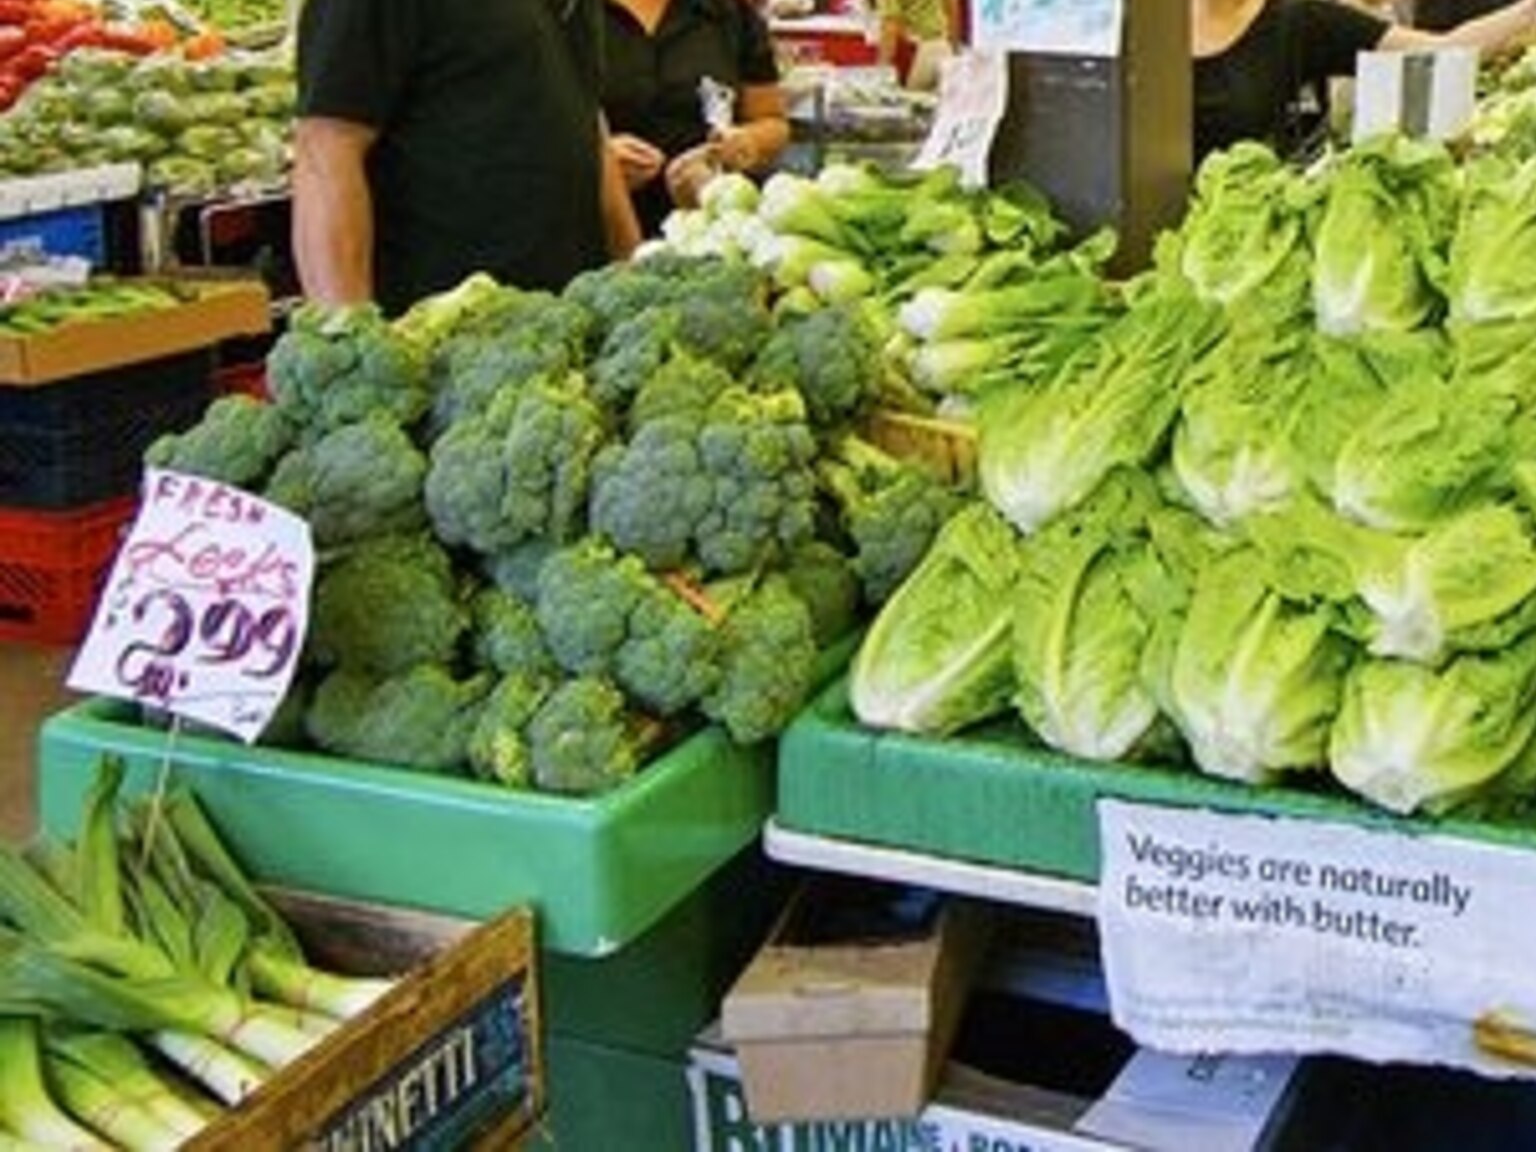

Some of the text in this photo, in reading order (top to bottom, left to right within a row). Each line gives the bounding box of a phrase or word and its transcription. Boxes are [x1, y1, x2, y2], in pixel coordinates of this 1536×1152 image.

[1125, 874, 1422, 948] better with butter.
[1126, 832, 1473, 916] Veggies are naturally
